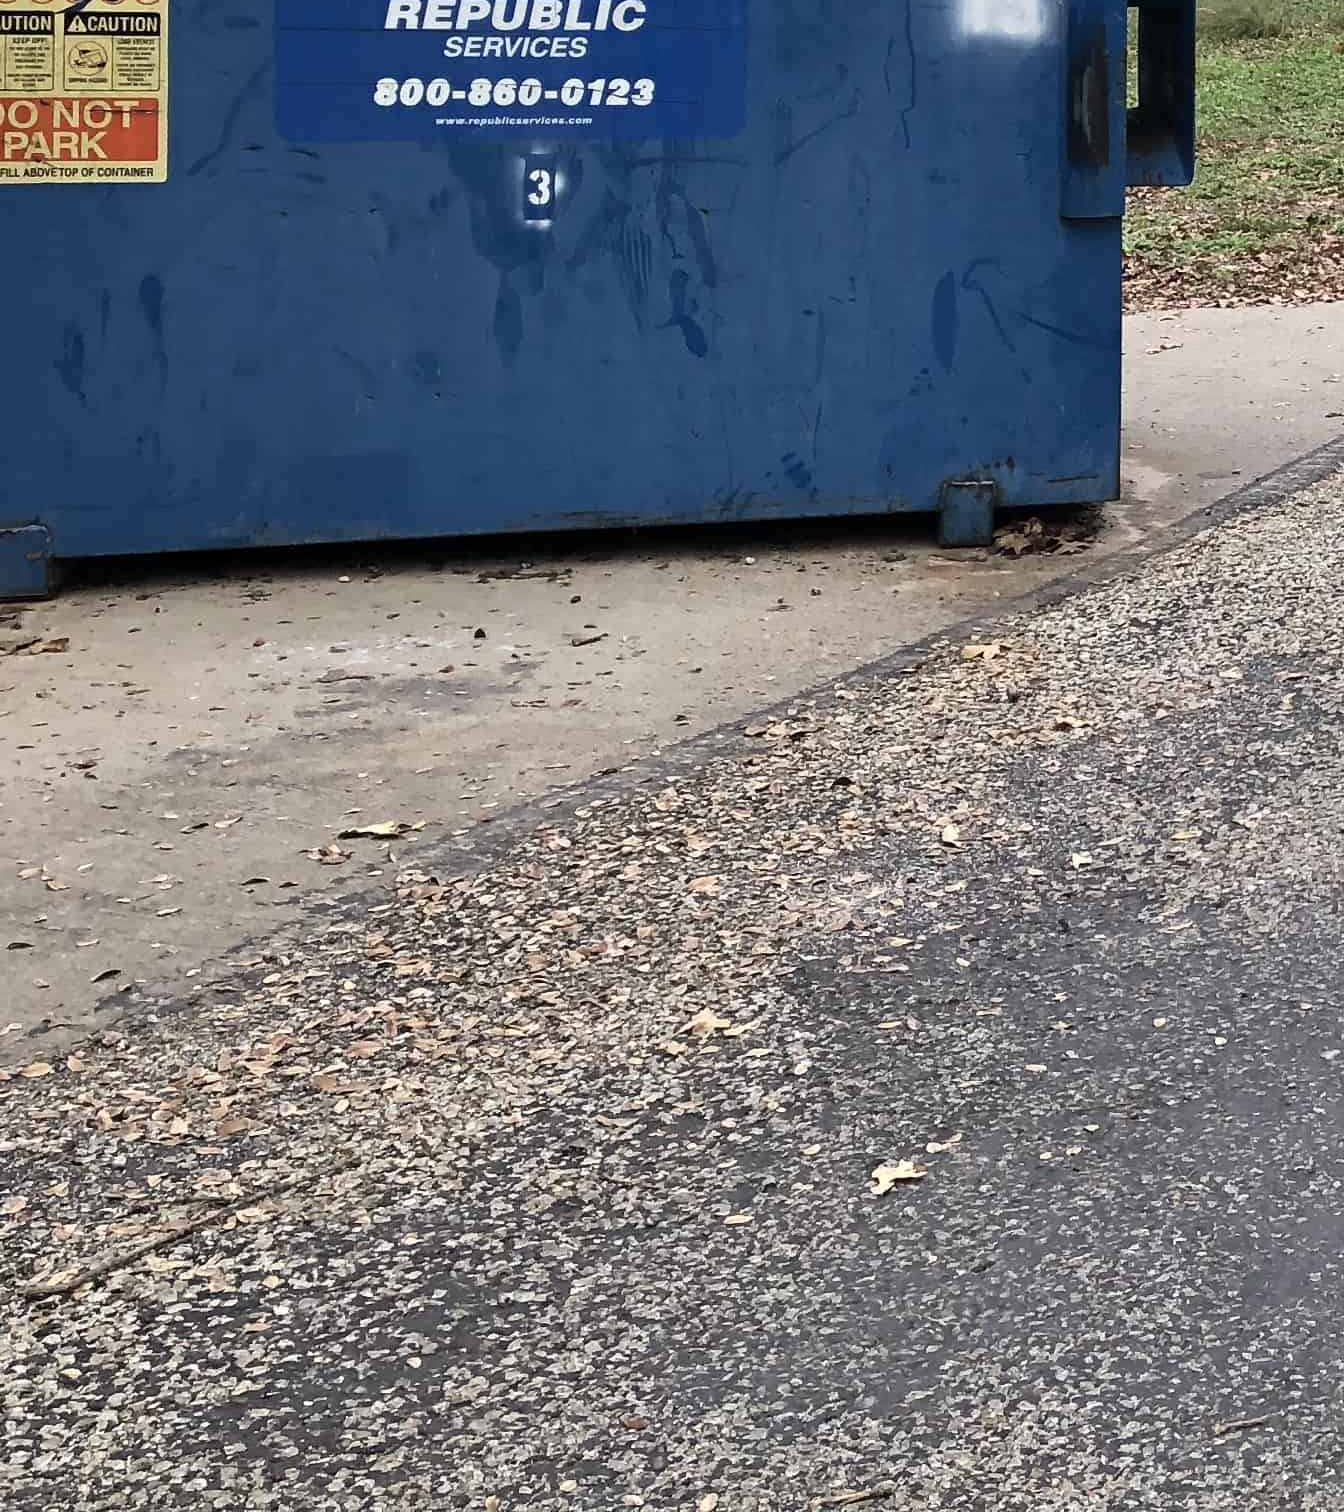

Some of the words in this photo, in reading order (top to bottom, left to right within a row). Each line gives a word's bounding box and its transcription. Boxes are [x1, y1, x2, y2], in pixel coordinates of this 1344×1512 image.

[0, 15, 52, 31] UTION
[87, 16, 158, 32] CAUTION
[443, 36, 589, 58] SERVICES
[373, 77, 656, 107] 800-860-0123
[0, 99, 39, 129] O
[53, 99, 141, 129] NOT
[435, 115, 593, 127] www.republicservices.com
[4, 131, 108, 160] PARK
[23, 168, 59, 178] ABOVE
[59, 168, 79, 178] TOP
[81, 168, 94, 178] OF
[97, 168, 154, 178] CONTAINER
[528, 169, 551, 206] 3
